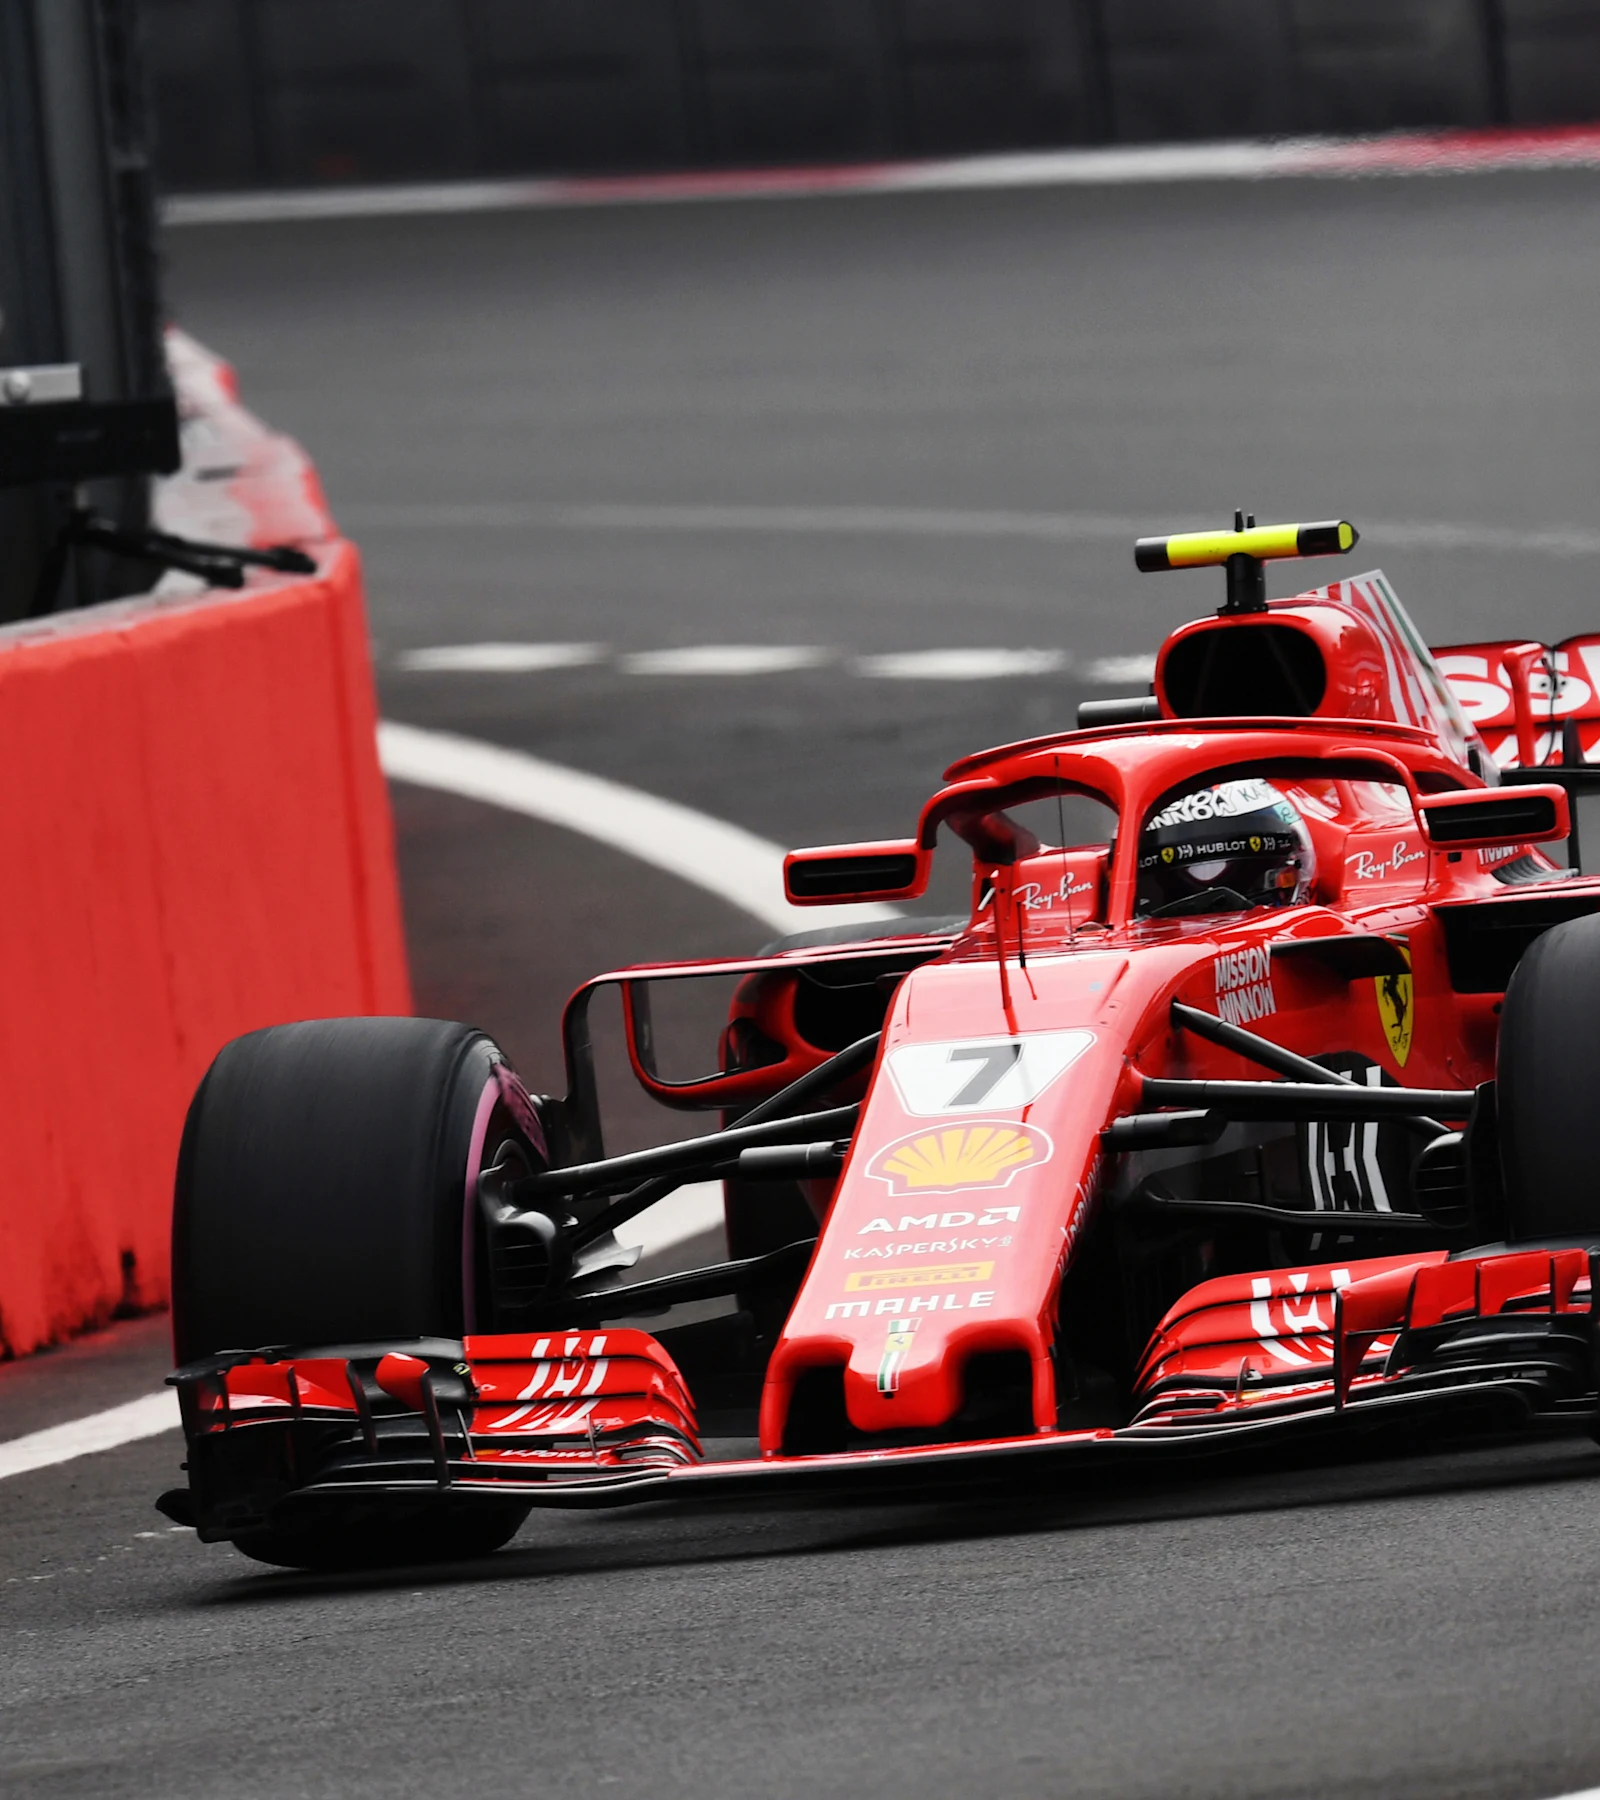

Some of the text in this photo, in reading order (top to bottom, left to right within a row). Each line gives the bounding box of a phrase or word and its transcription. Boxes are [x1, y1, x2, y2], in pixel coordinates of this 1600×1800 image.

[1196, 841, 1246, 854] HUBLOT
[1344, 841, 1426, 880] Ray-Ban
[1012, 872, 1093, 910] Ray-Ban
[1214, 946, 1271, 993] MISSION
[1216, 980, 1277, 1027] WINNOW
[945, 1043, 1025, 1108] 7
[856, 1211, 976, 1236] AMD
[843, 1237, 998, 1260] KASPERSKY
[856, 1266, 981, 1288] PIRELLI
[824, 1291, 996, 1320] MAHLE
